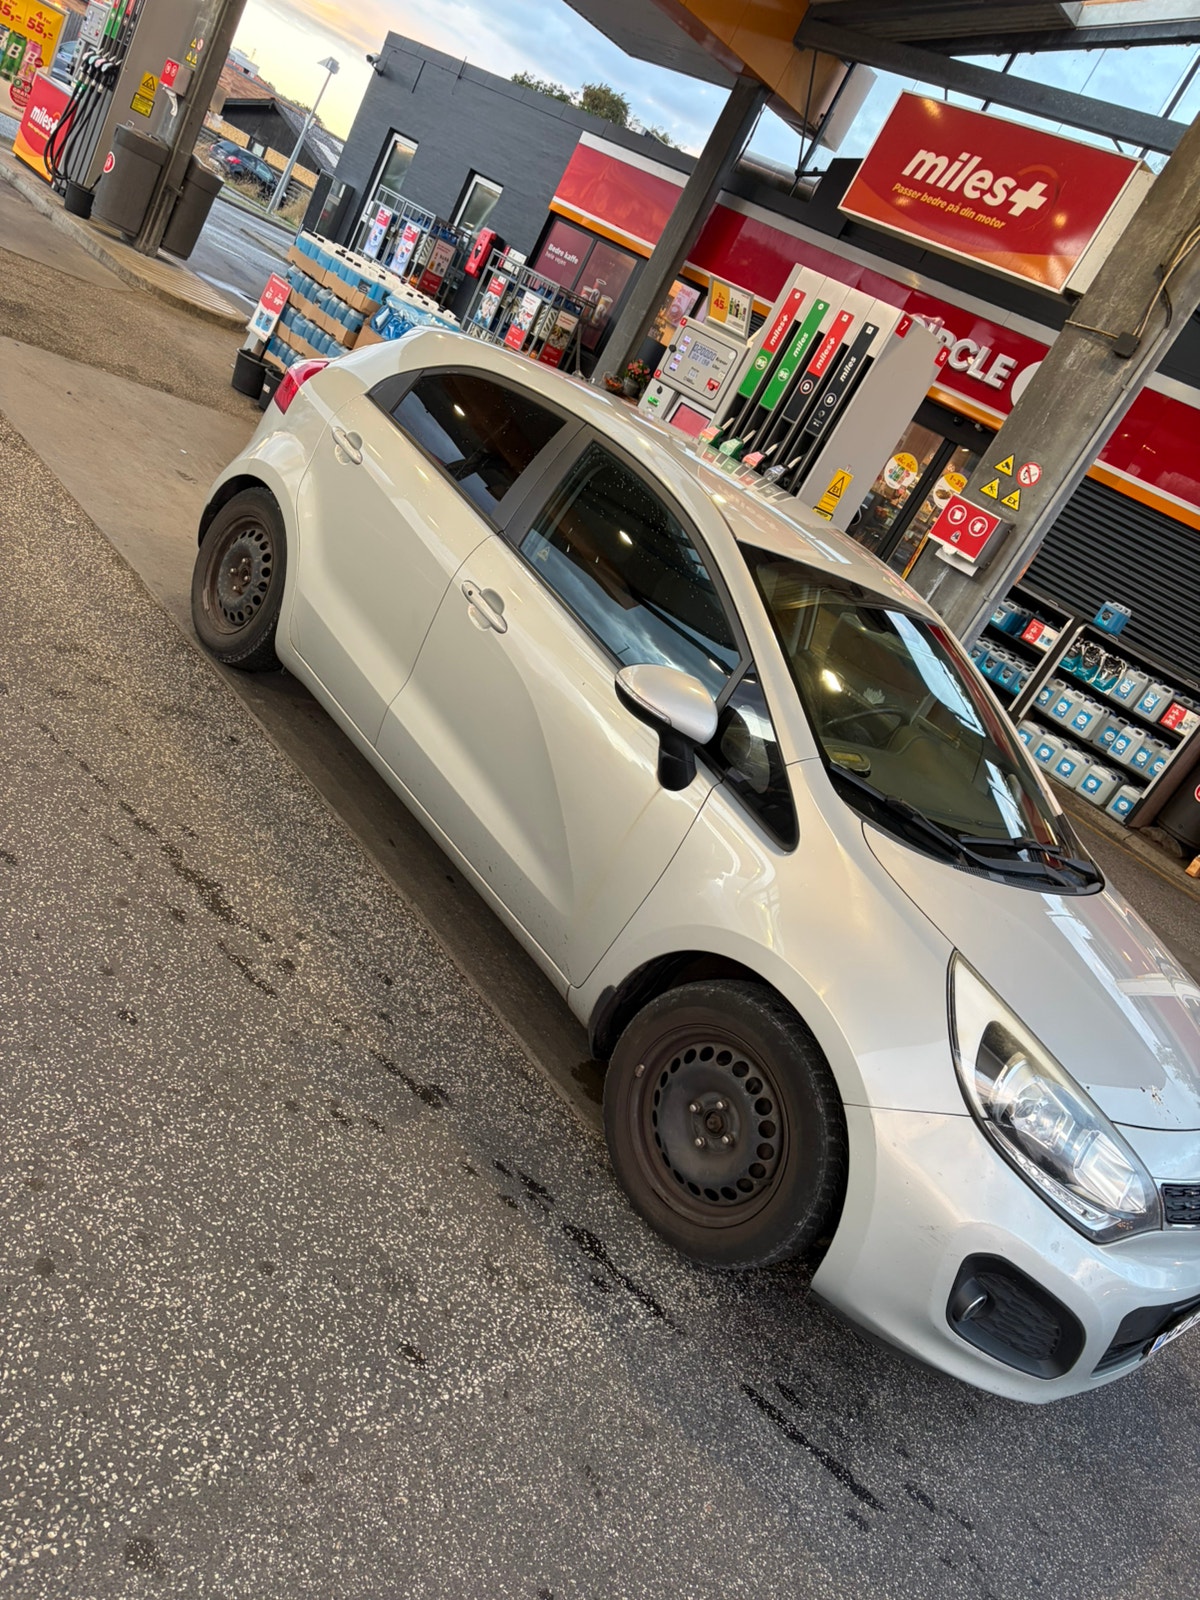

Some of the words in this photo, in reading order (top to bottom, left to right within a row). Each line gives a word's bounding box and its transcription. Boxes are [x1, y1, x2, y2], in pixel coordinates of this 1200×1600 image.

[0, 2, 23, 24] 5,-
[901, 149, 1048, 217] miles+
[892, 182, 922, 200] Passer
[920, 191, 947, 209] bedre
[945, 201, 961, 214] på
[959, 204, 975, 220] din
[974, 212, 1006, 230] motor
[563, 251, 579, 265] kaffe
[770, 313, 789, 346] miles+
[900, 320, 908, 331] 7
[792, 332, 809, 358] miles
[815, 337, 836, 370] miles+
[939, 351, 947, 362] 8
[839, 356, 857, 383] miles
[1006, 496, 1018, 506] EX
